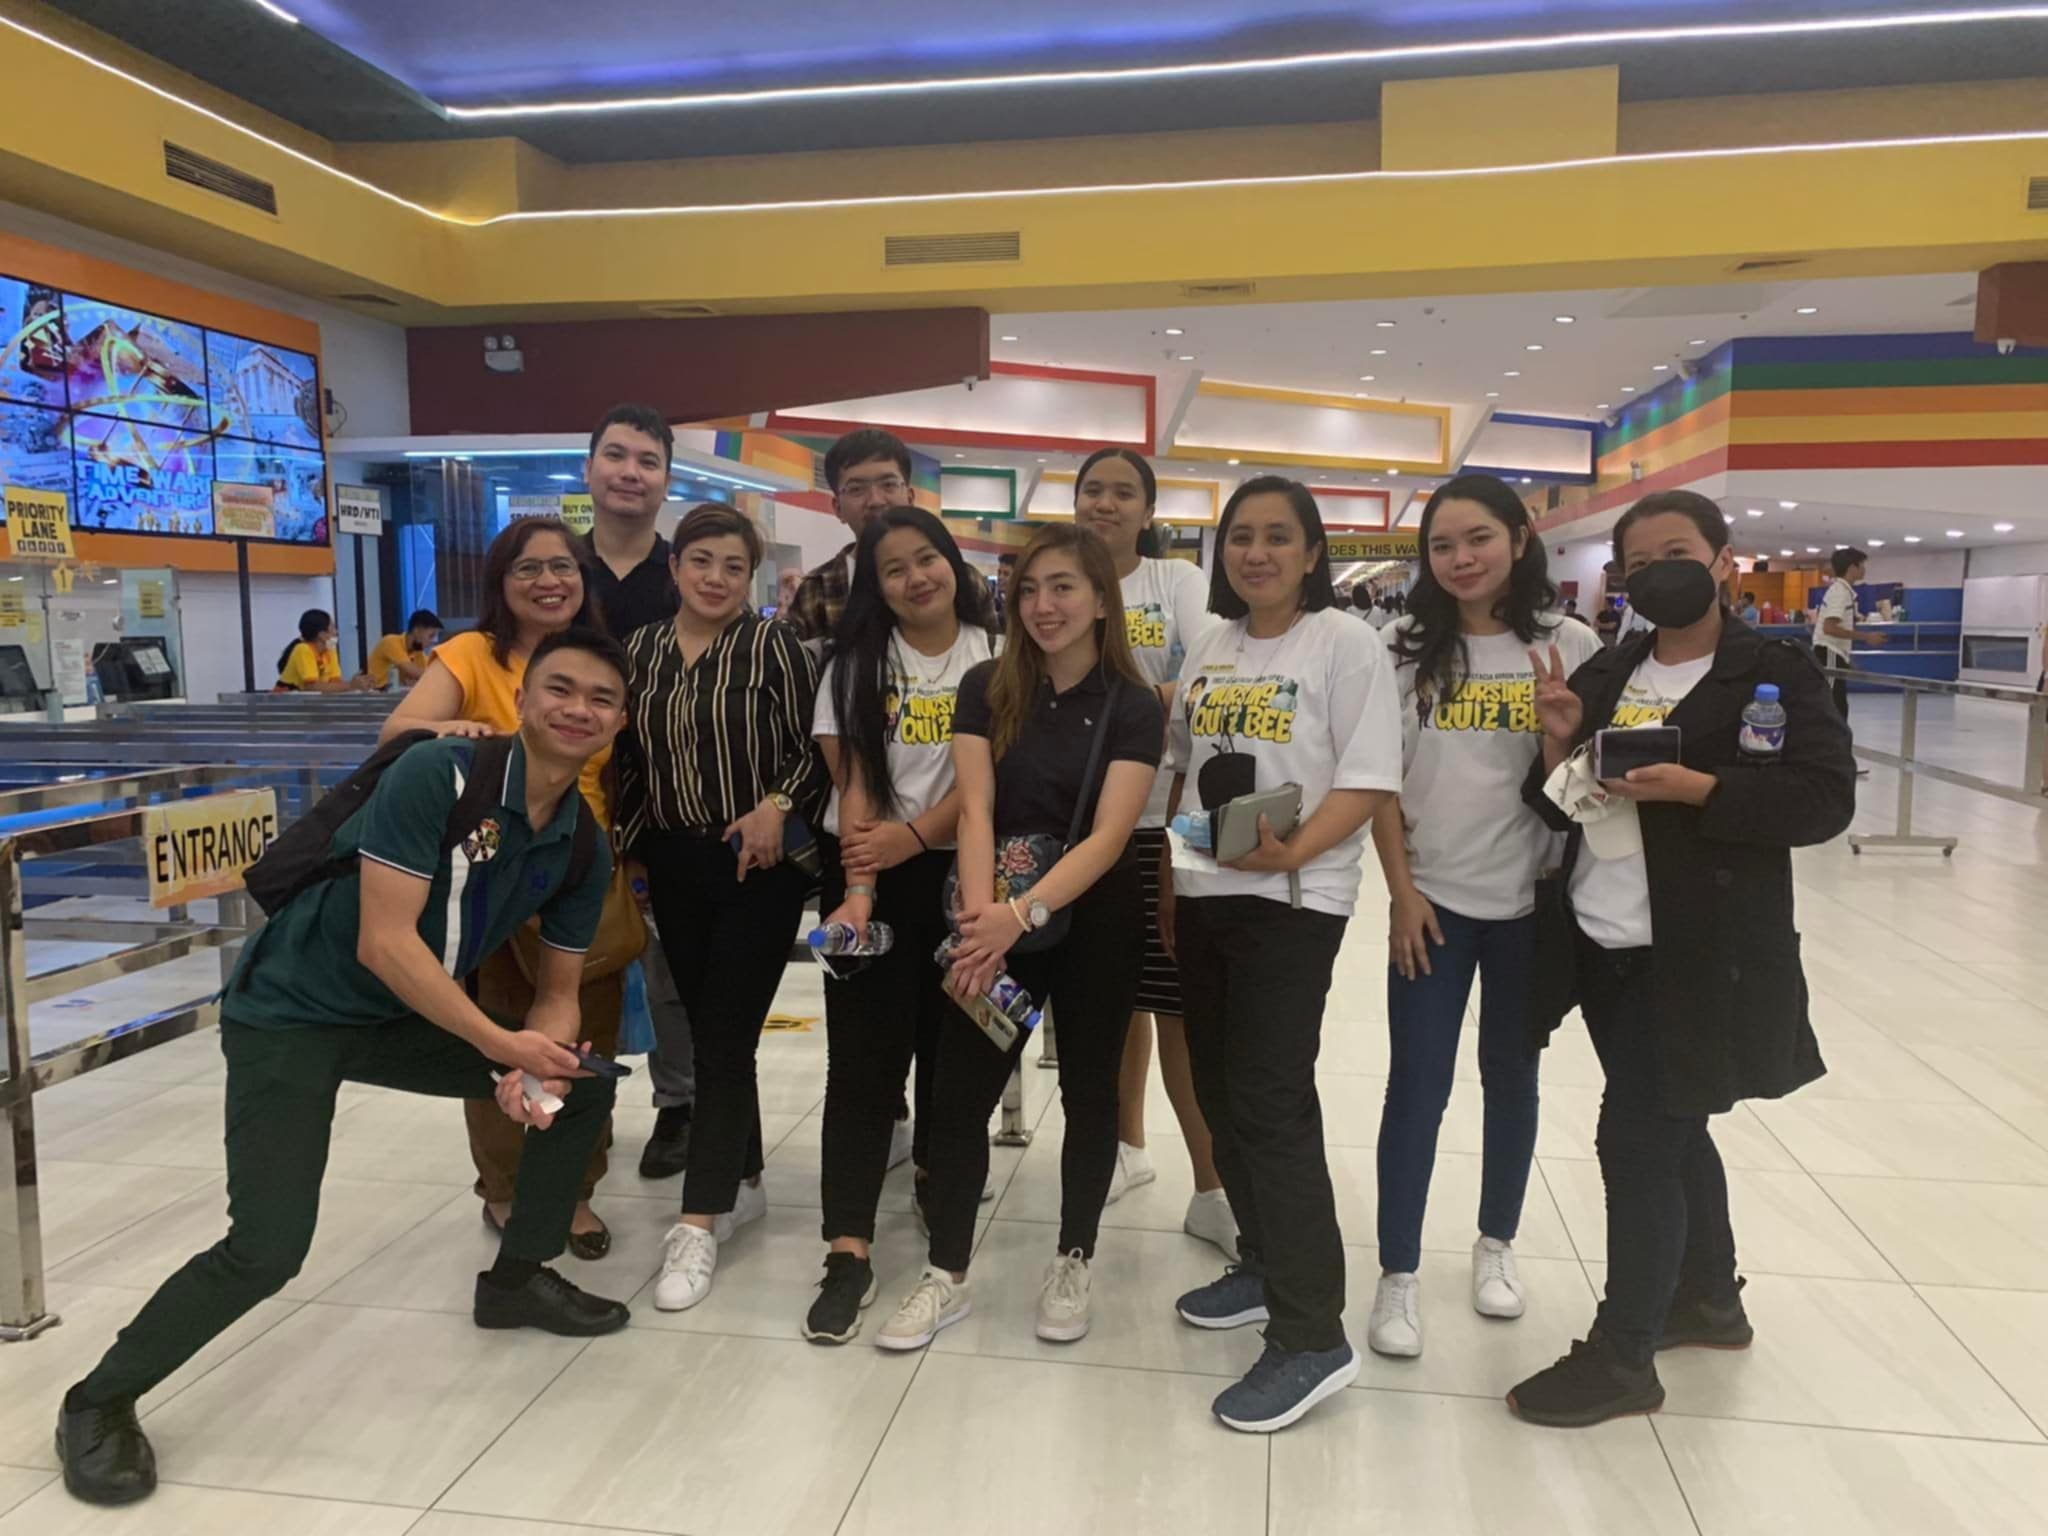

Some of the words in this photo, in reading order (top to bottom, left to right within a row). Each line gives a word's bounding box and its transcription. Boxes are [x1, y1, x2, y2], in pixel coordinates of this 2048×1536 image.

[8, 500, 65, 522] PRIORITY
[22, 519, 58, 540] LANE
[1329, 544, 1357, 556] DES
[1361, 543, 1391, 556] THIS
[1395, 543, 1418, 555] WA
[1127, 623, 1166, 648] BEE
[909, 694, 956, 717] NURSI
[1205, 682, 1280, 707] NURSING
[1243, 705, 1296, 744] BEE
[1435, 700, 1500, 731] QUIZ
[901, 715, 954, 745] QUIZ
[154, 815, 274, 883] ENTRANCE
